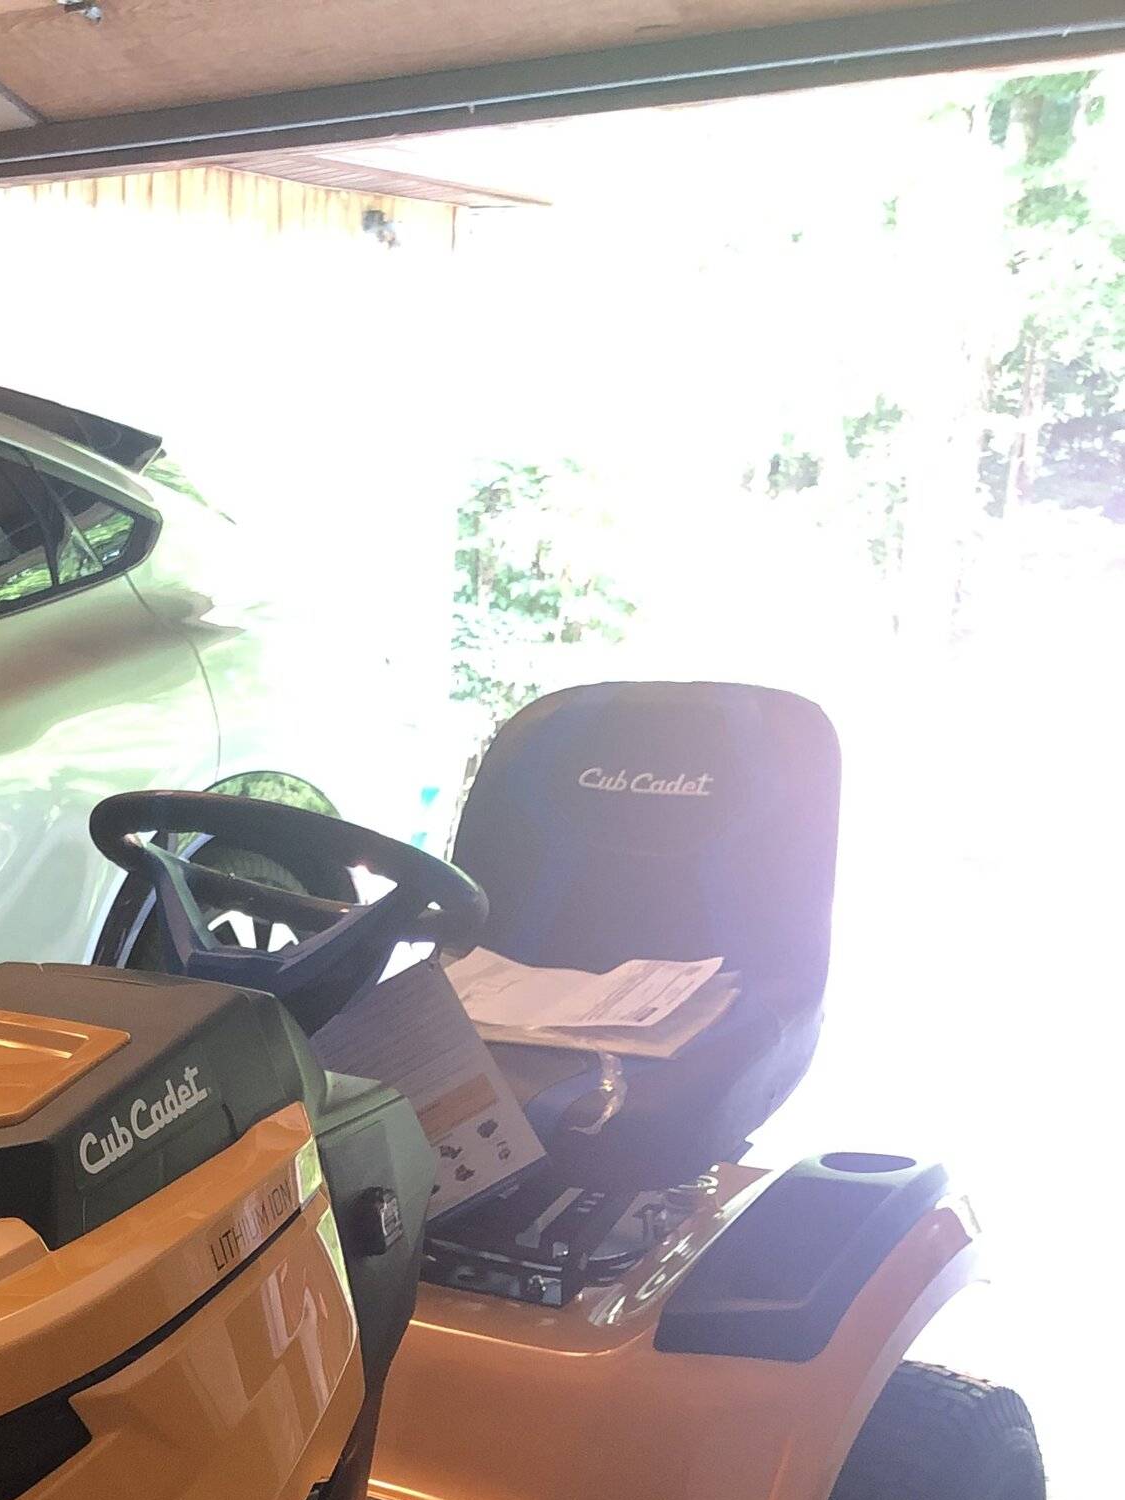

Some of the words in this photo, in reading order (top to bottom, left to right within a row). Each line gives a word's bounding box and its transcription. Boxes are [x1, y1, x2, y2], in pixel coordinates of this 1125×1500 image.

[578, 767, 627, 791] Cub
[630, 772, 714, 796] Cadet
[79, 1116, 134, 1174] Cub
[130, 1066, 208, 1140] Cadet
[210, 1199, 270, 1271] LITHIUM
[267, 1179, 293, 1221] ION
